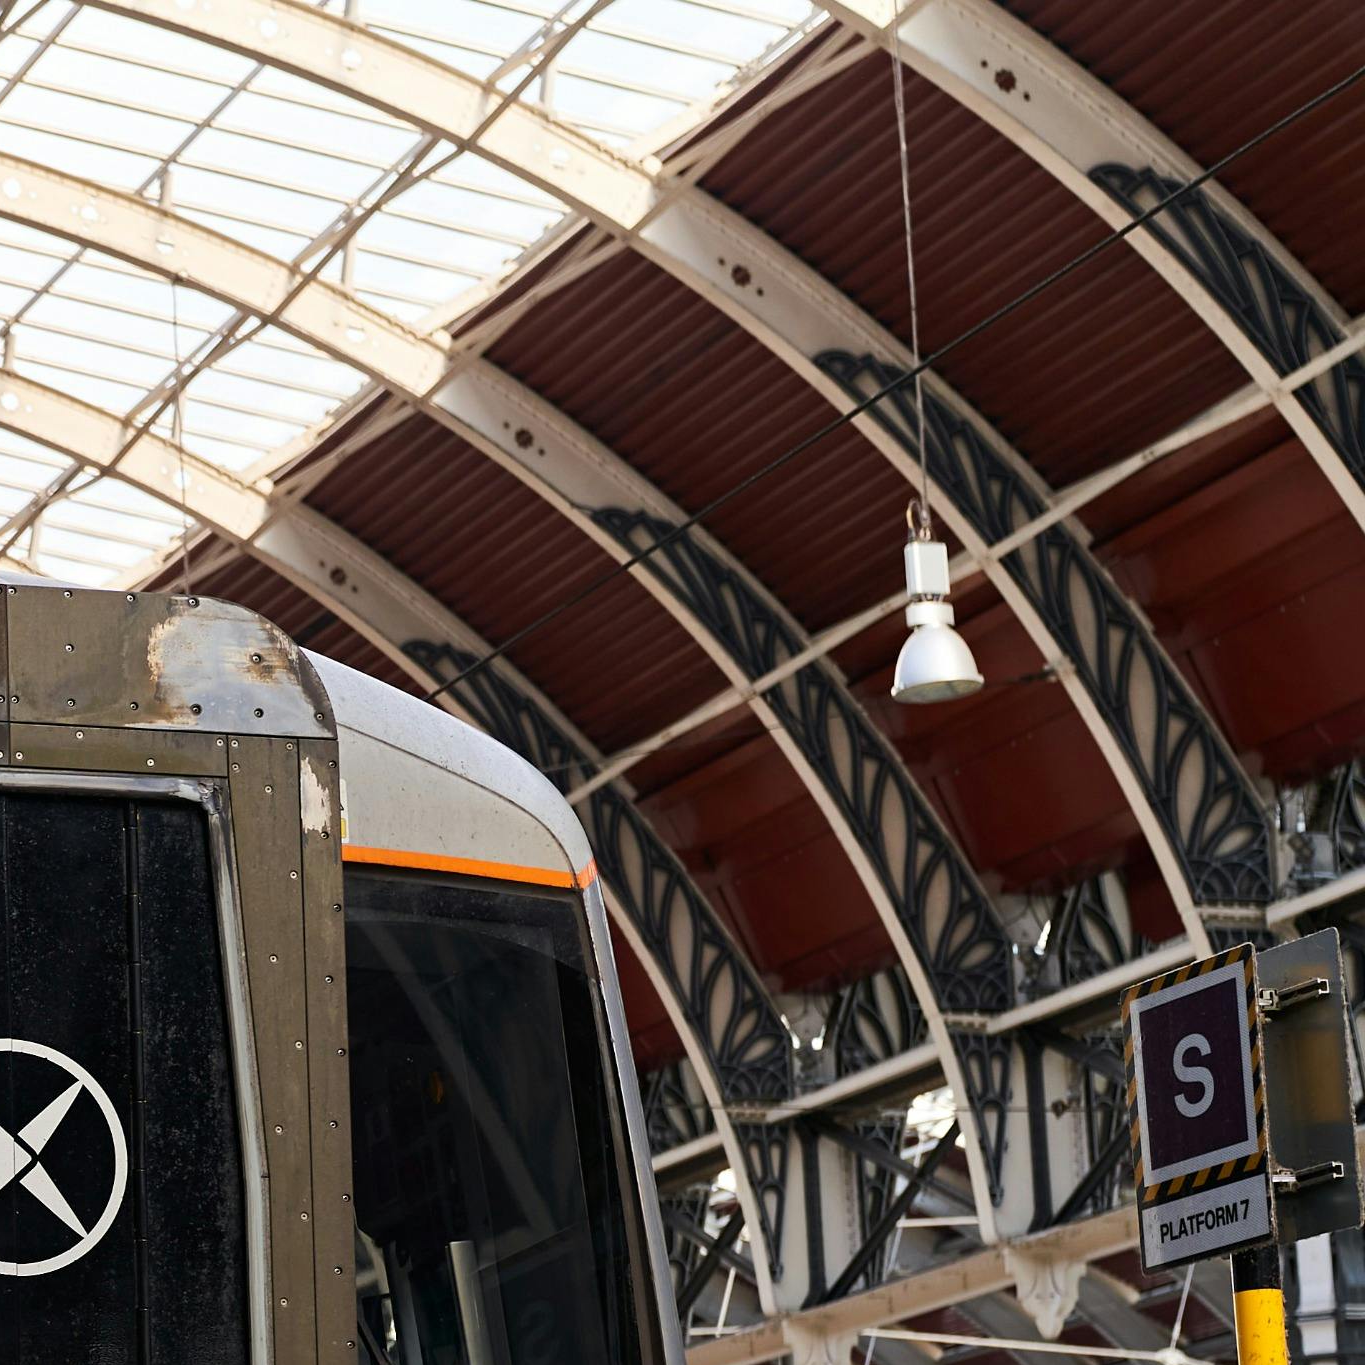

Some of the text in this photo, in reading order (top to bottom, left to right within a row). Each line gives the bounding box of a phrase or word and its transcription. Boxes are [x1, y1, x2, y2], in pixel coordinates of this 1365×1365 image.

[1173, 1033, 1215, 1118] S
[1160, 1199, 1250, 1244] PLATFORM 7
